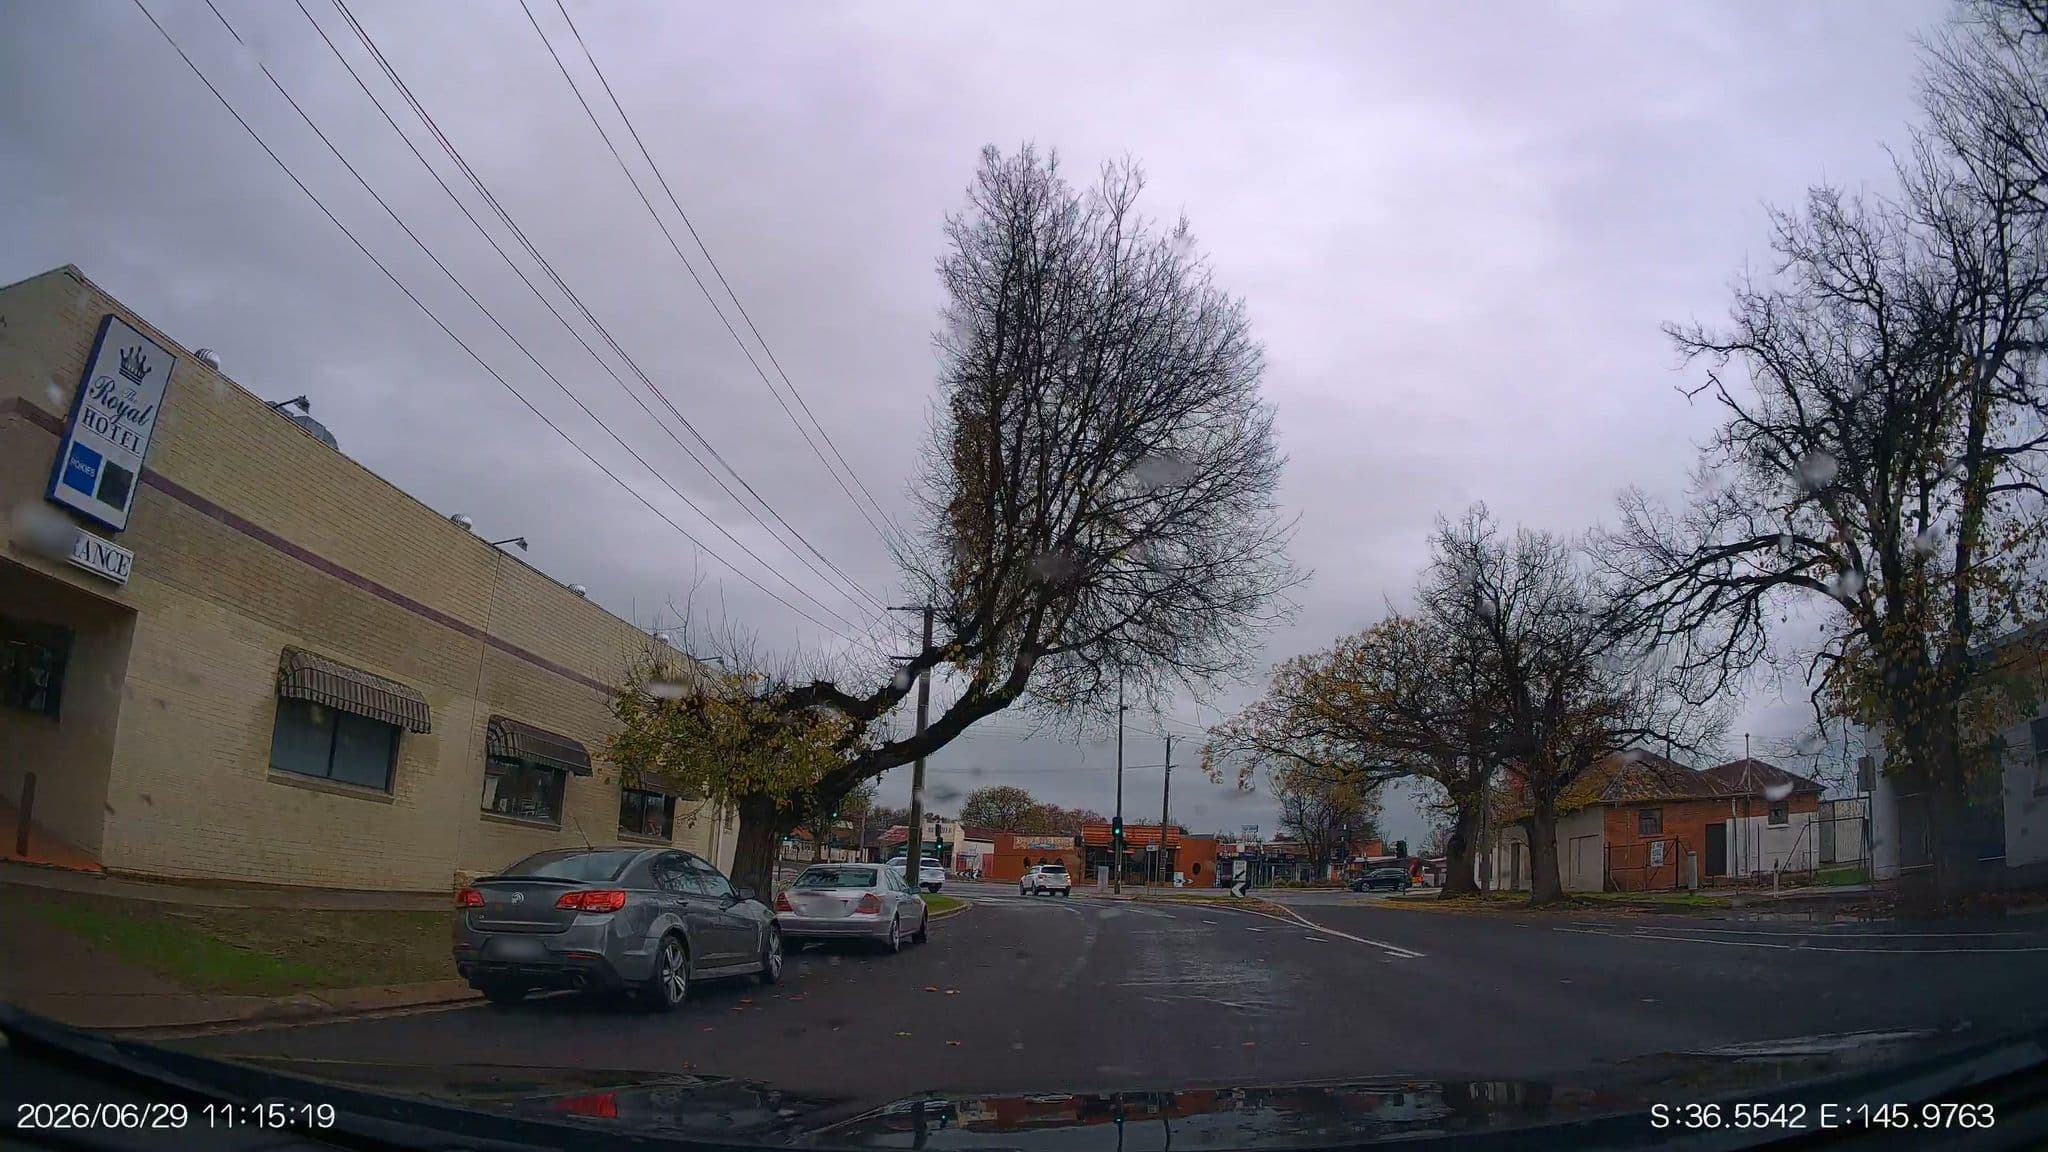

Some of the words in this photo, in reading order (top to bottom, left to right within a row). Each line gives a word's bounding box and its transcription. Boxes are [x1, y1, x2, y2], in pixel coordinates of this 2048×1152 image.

[89, 375, 154, 426] Royal
[83, 407, 141, 455] HOTEL
[73, 536, 131, 577] ANCE
